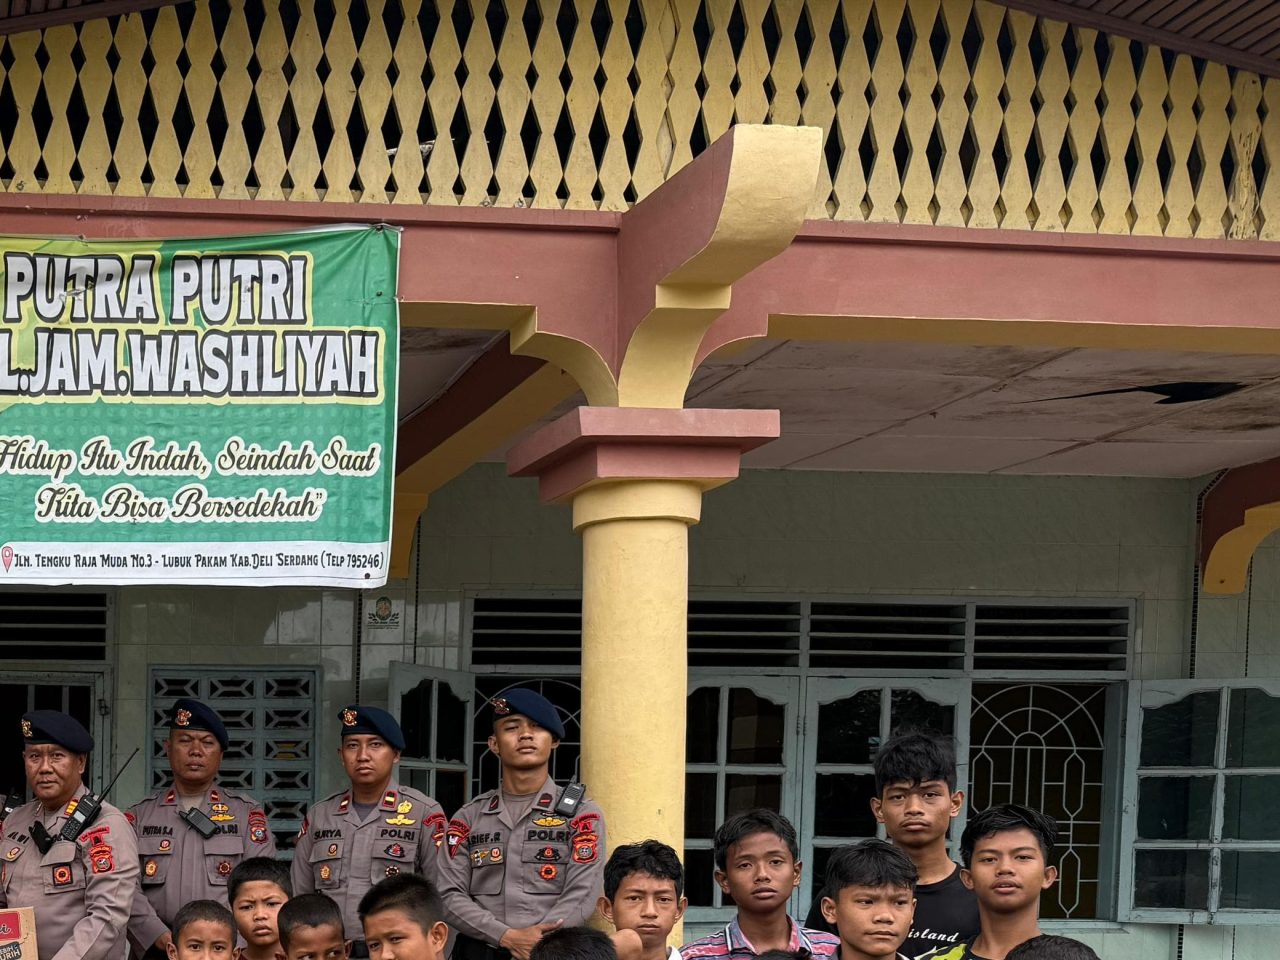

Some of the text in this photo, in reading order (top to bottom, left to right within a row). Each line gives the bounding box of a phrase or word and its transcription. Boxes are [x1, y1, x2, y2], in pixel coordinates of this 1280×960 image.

[3, 252, 160, 323] PUTRA
[169, 254, 308, 326] PUTRI
[81, 439, 120, 470] Itu
[126, 440, 207, 474] Indah,
[218, 440, 315, 471] Seindah
[321, 440, 375, 470] Saat
[37, 487, 94, 518] Kita
[101, 487, 165, 518] Bisa
[215, 823, 238, 835] OLRI
[314, 829, 341, 840] SURYA
[380, 829, 415, 841] POLRI
